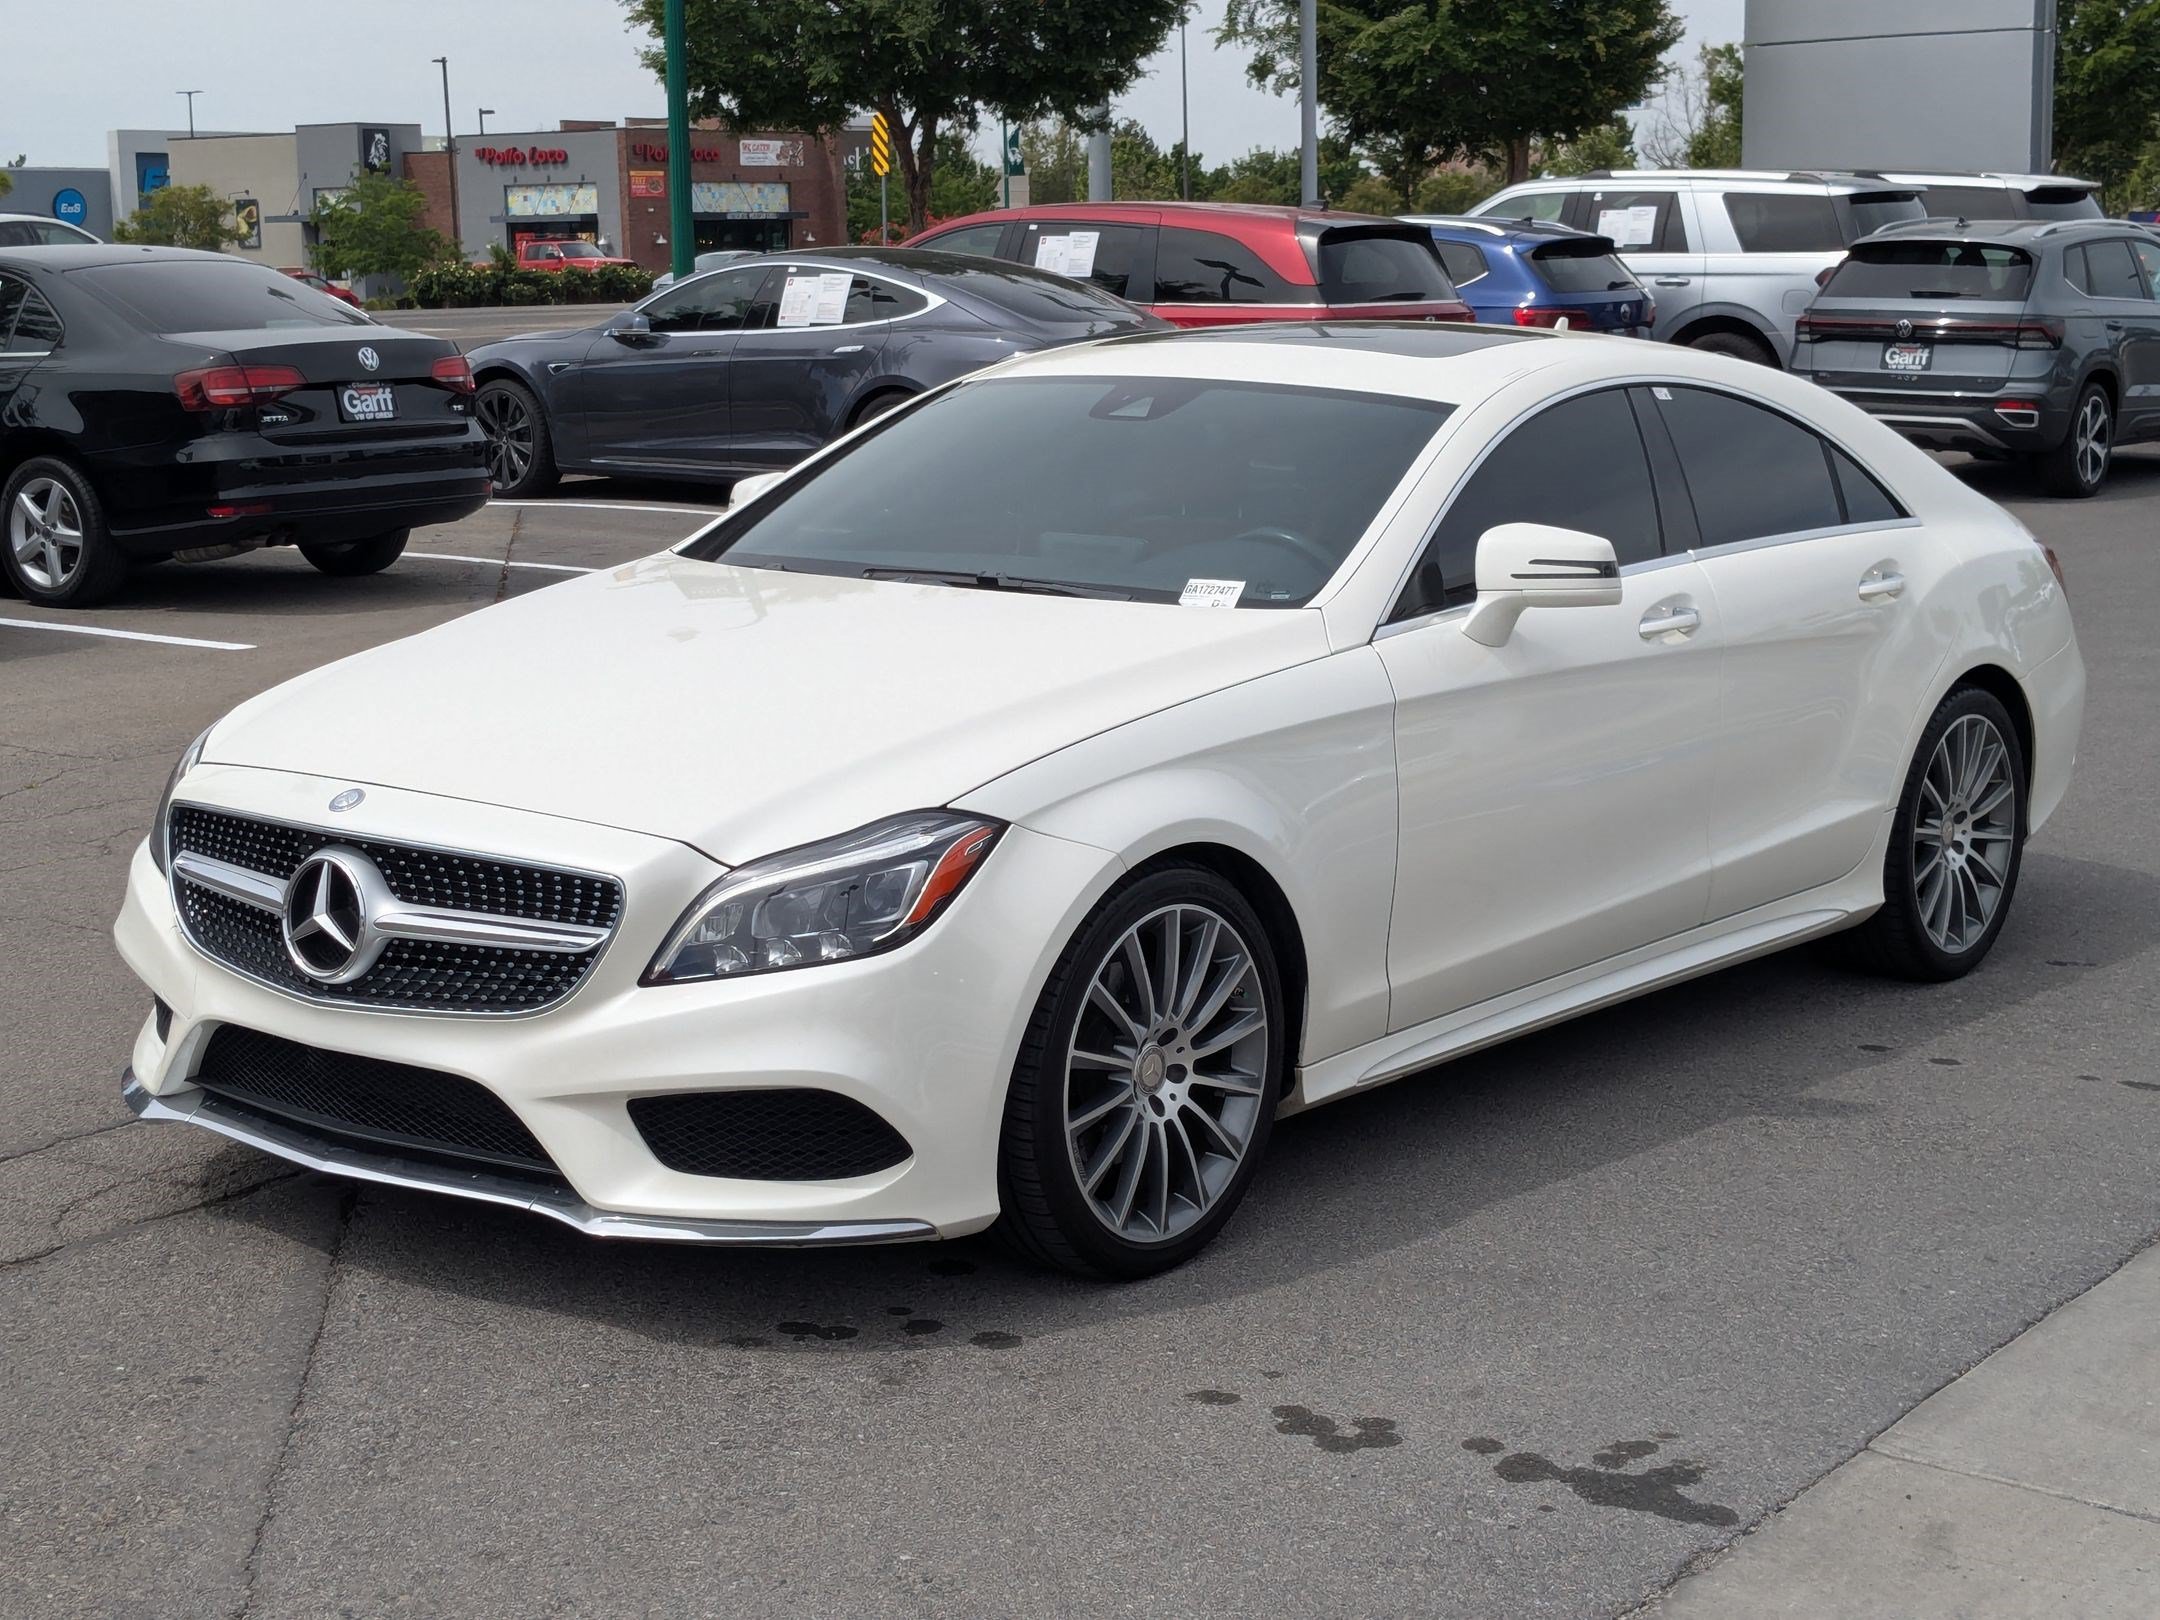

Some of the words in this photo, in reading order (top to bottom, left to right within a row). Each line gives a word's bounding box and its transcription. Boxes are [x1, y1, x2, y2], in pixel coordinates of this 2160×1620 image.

[485, 146, 526, 165] Pollo
[528, 146, 568, 165] Loco
[1885, 347, 1929, 365] Garff
[343, 387, 394, 413] Garff
[260, 415, 289, 423] JETTA
